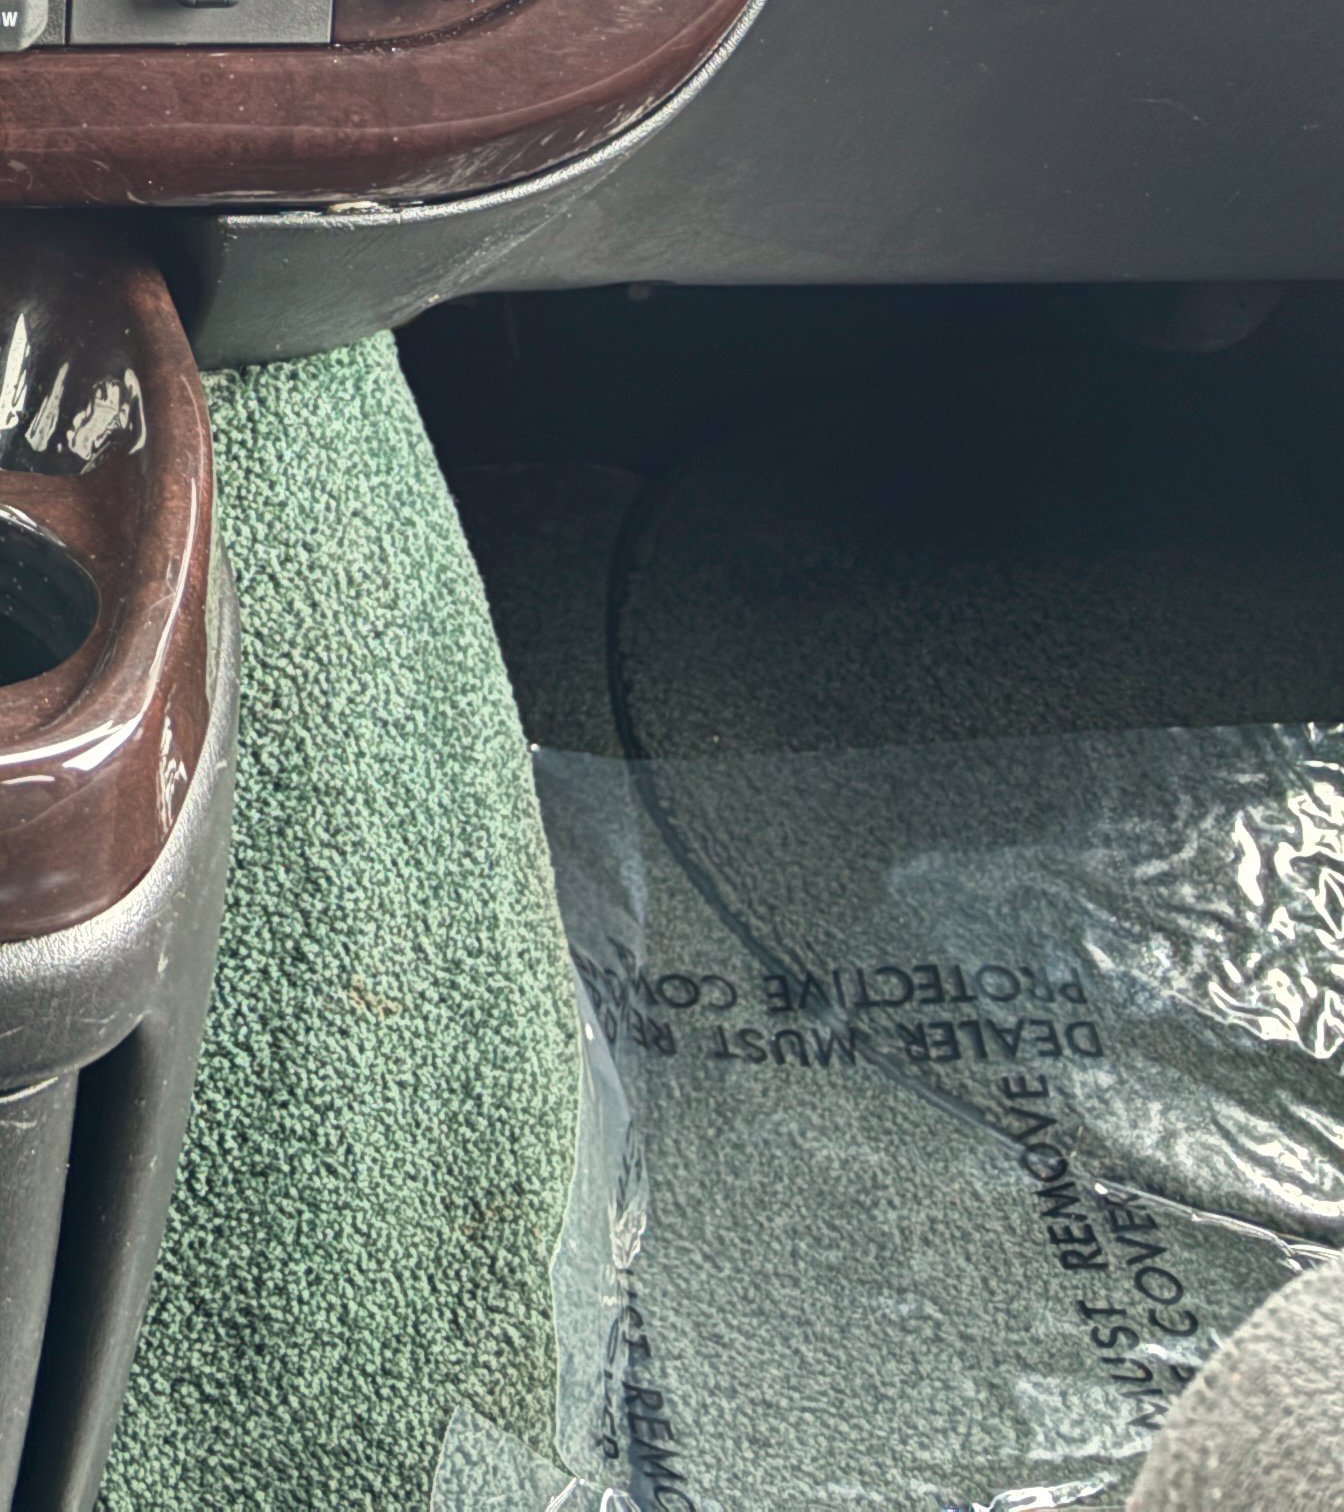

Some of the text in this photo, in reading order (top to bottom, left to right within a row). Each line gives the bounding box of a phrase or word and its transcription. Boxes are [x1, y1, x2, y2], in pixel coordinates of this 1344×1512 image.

[763, 962, 1088, 1014] PROTECTIVE
[712, 1023, 859, 1068] MUST
[896, 1017, 1105, 1063] DEALER
[999, 1074, 1170, 1431] MUST REMOVE
